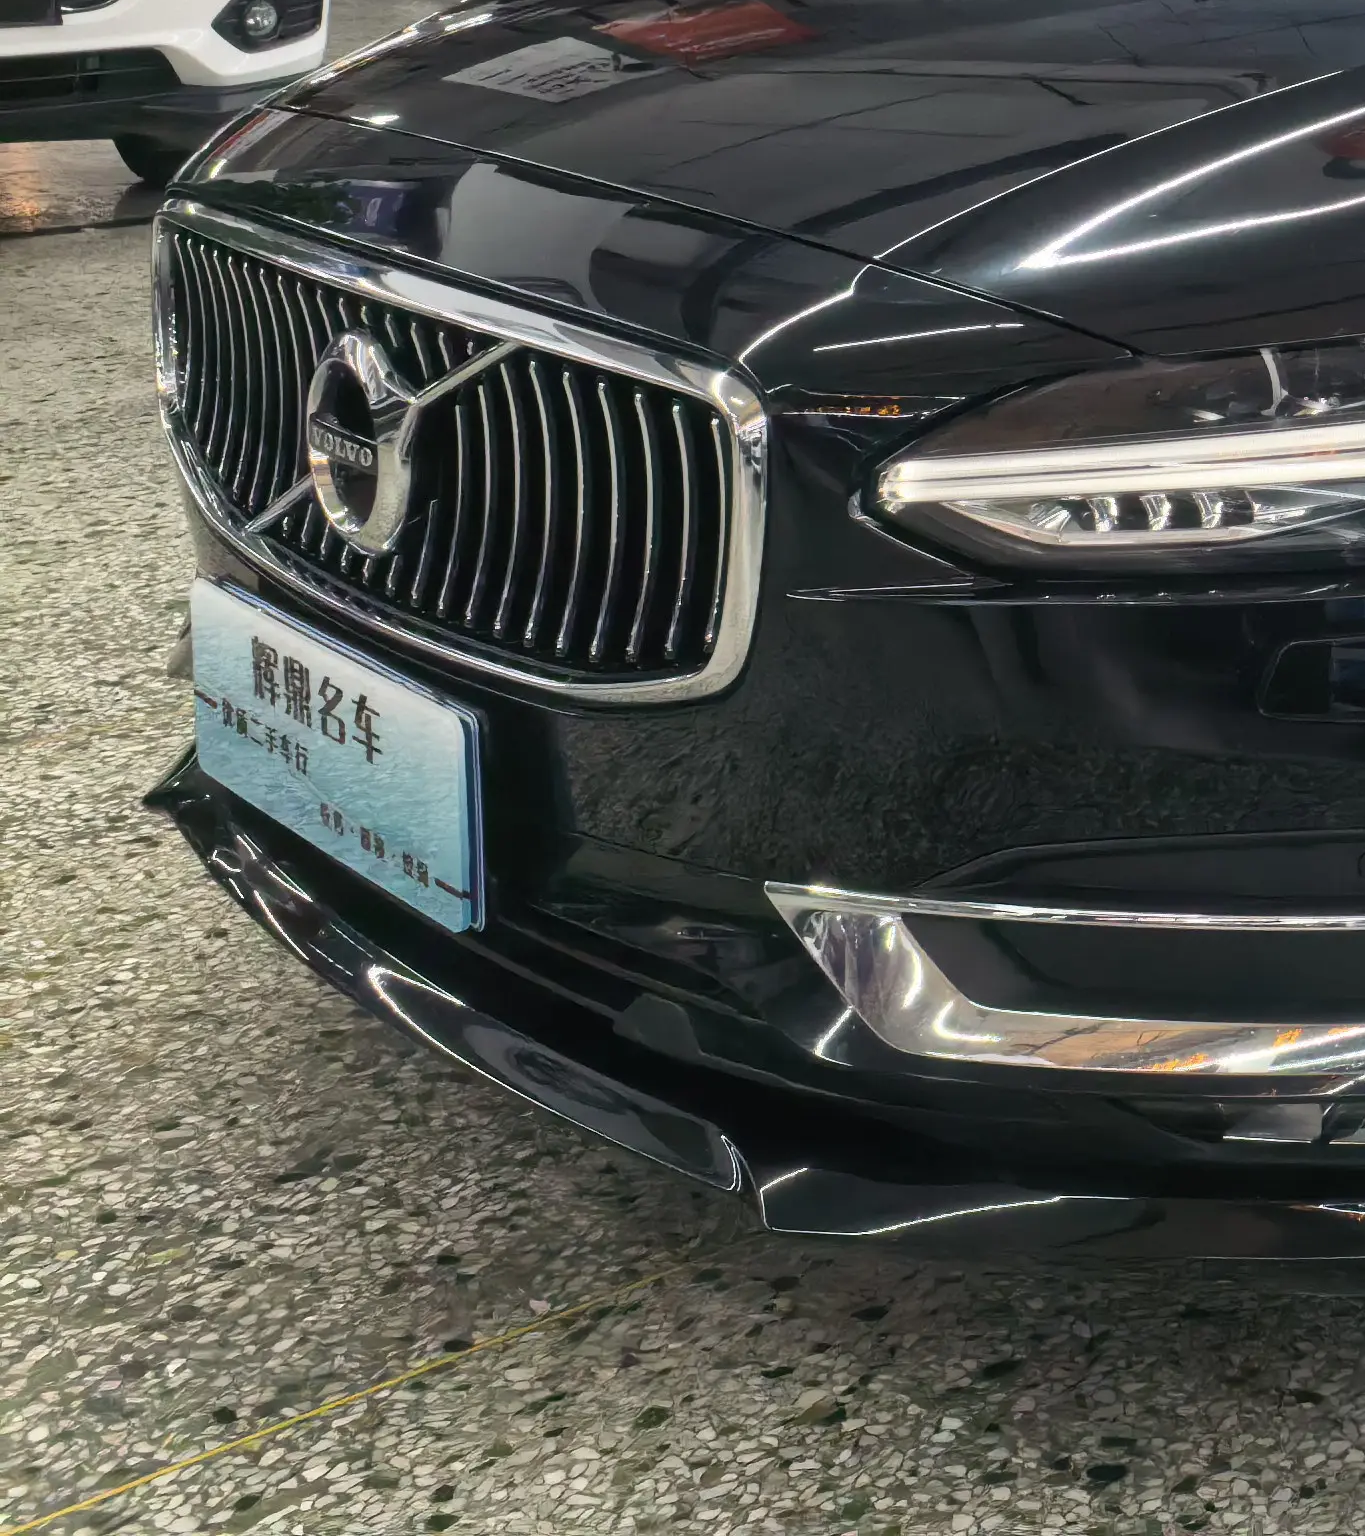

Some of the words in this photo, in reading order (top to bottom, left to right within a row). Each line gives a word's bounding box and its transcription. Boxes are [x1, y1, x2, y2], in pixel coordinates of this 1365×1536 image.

[311, 425, 373, 467] VOLVO
[251, 635, 383, 765] 辉鼎名车
